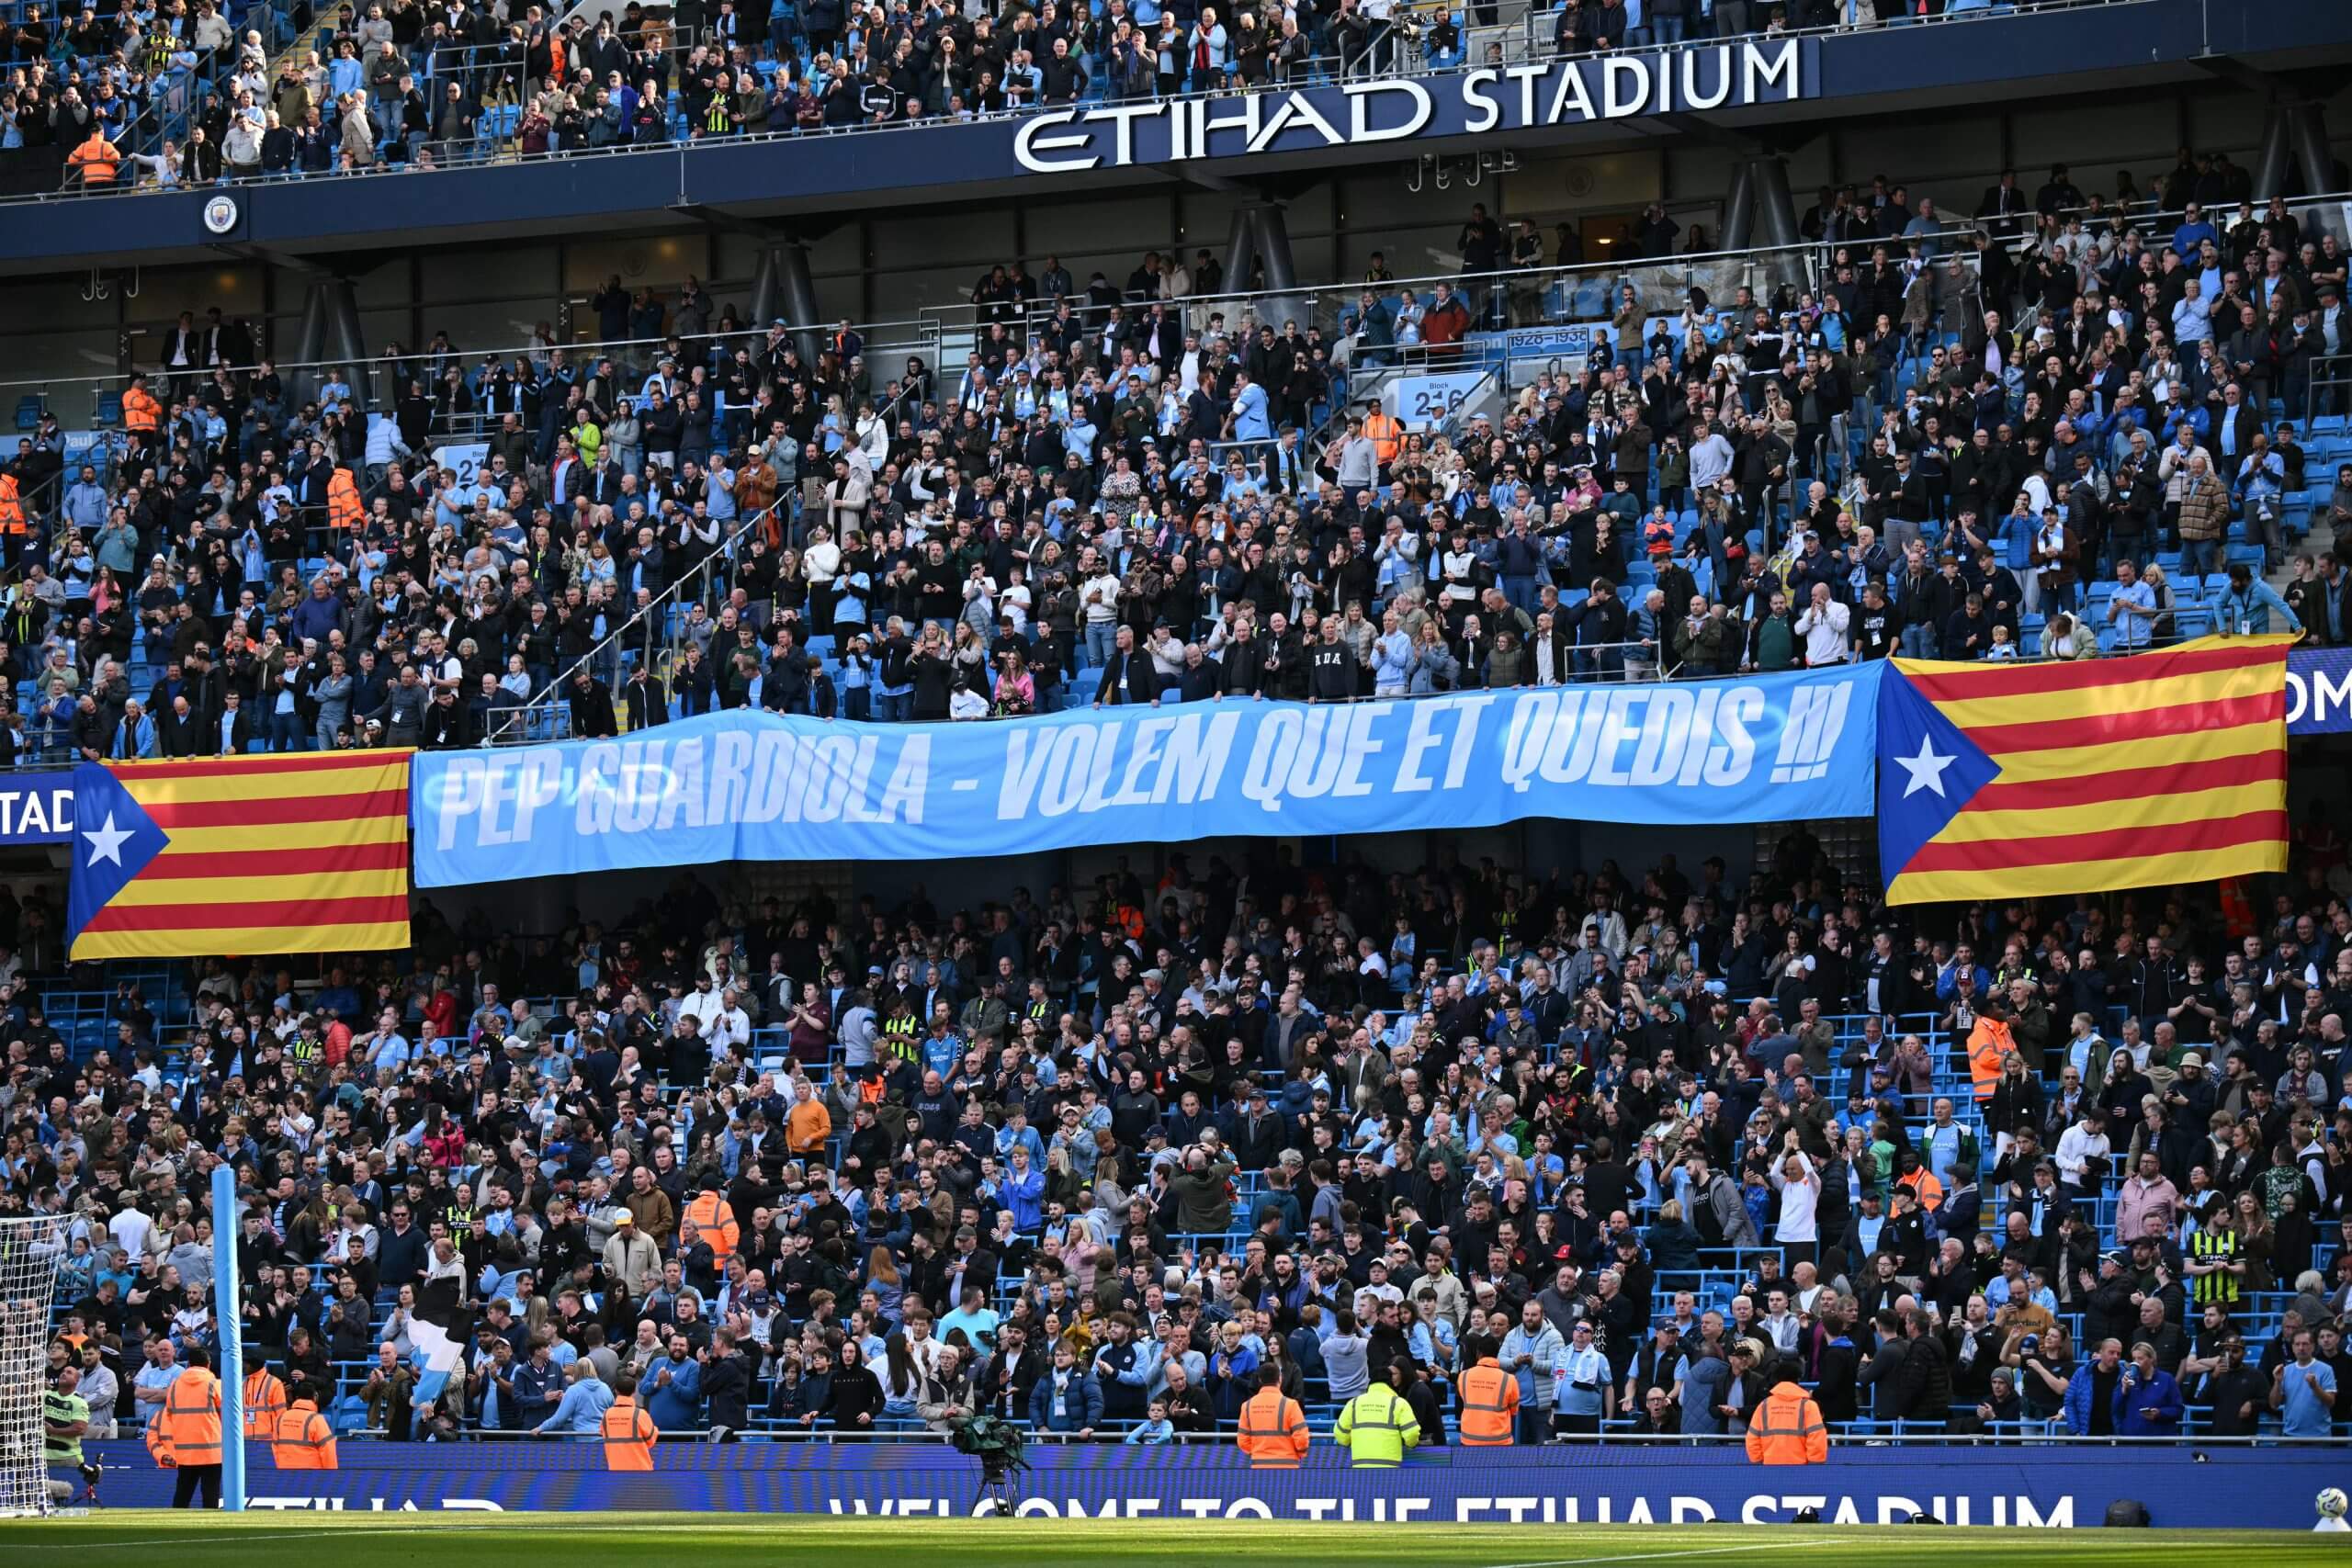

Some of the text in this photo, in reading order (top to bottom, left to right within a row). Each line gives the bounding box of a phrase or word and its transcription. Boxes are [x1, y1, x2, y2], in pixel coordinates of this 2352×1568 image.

[1014, 39, 1799, 174] ETIHAD STADIUM
[1430, 381, 1449, 389] Block
[98, 432, 128, 446] 150
[459, 458, 485, 482] 21
[436, 748, 561, 852] PEP
[575, 729, 933, 836] GUARDIOLA
[997, 710, 1242, 820] VOLEM
[1242, 704, 1393, 812] QUE
[1392, 694, 1498, 793] ET
[1501, 685, 1766, 794] QUEDIS
[1770, 680, 1854, 784] !!!
